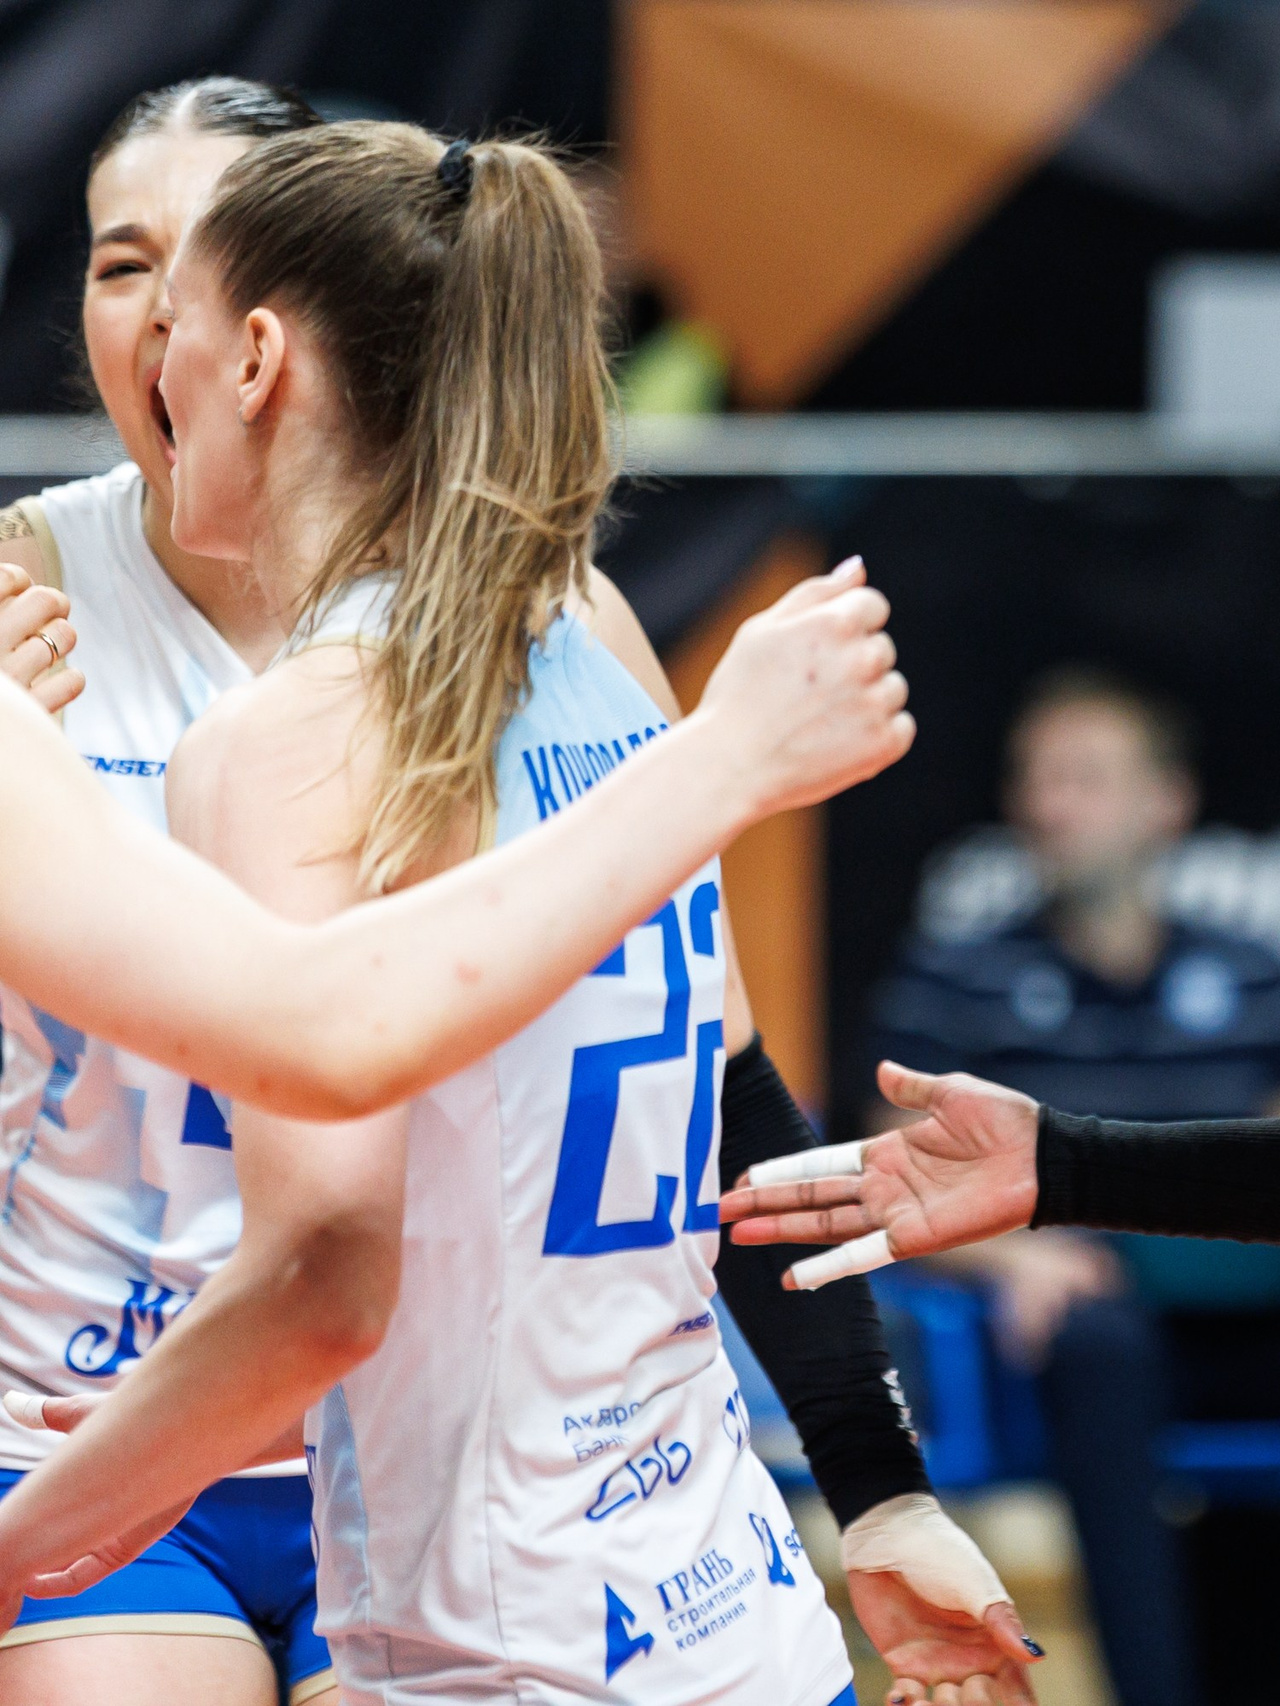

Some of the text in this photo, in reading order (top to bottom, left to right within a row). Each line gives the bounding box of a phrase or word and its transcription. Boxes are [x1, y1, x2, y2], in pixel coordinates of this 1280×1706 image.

[84, 756, 167, 777] NSE
[655, 1549, 735, 1615] ГРАНЬ
[667, 1567, 757, 1633] строительная
[675, 1602, 748, 1652] компания
